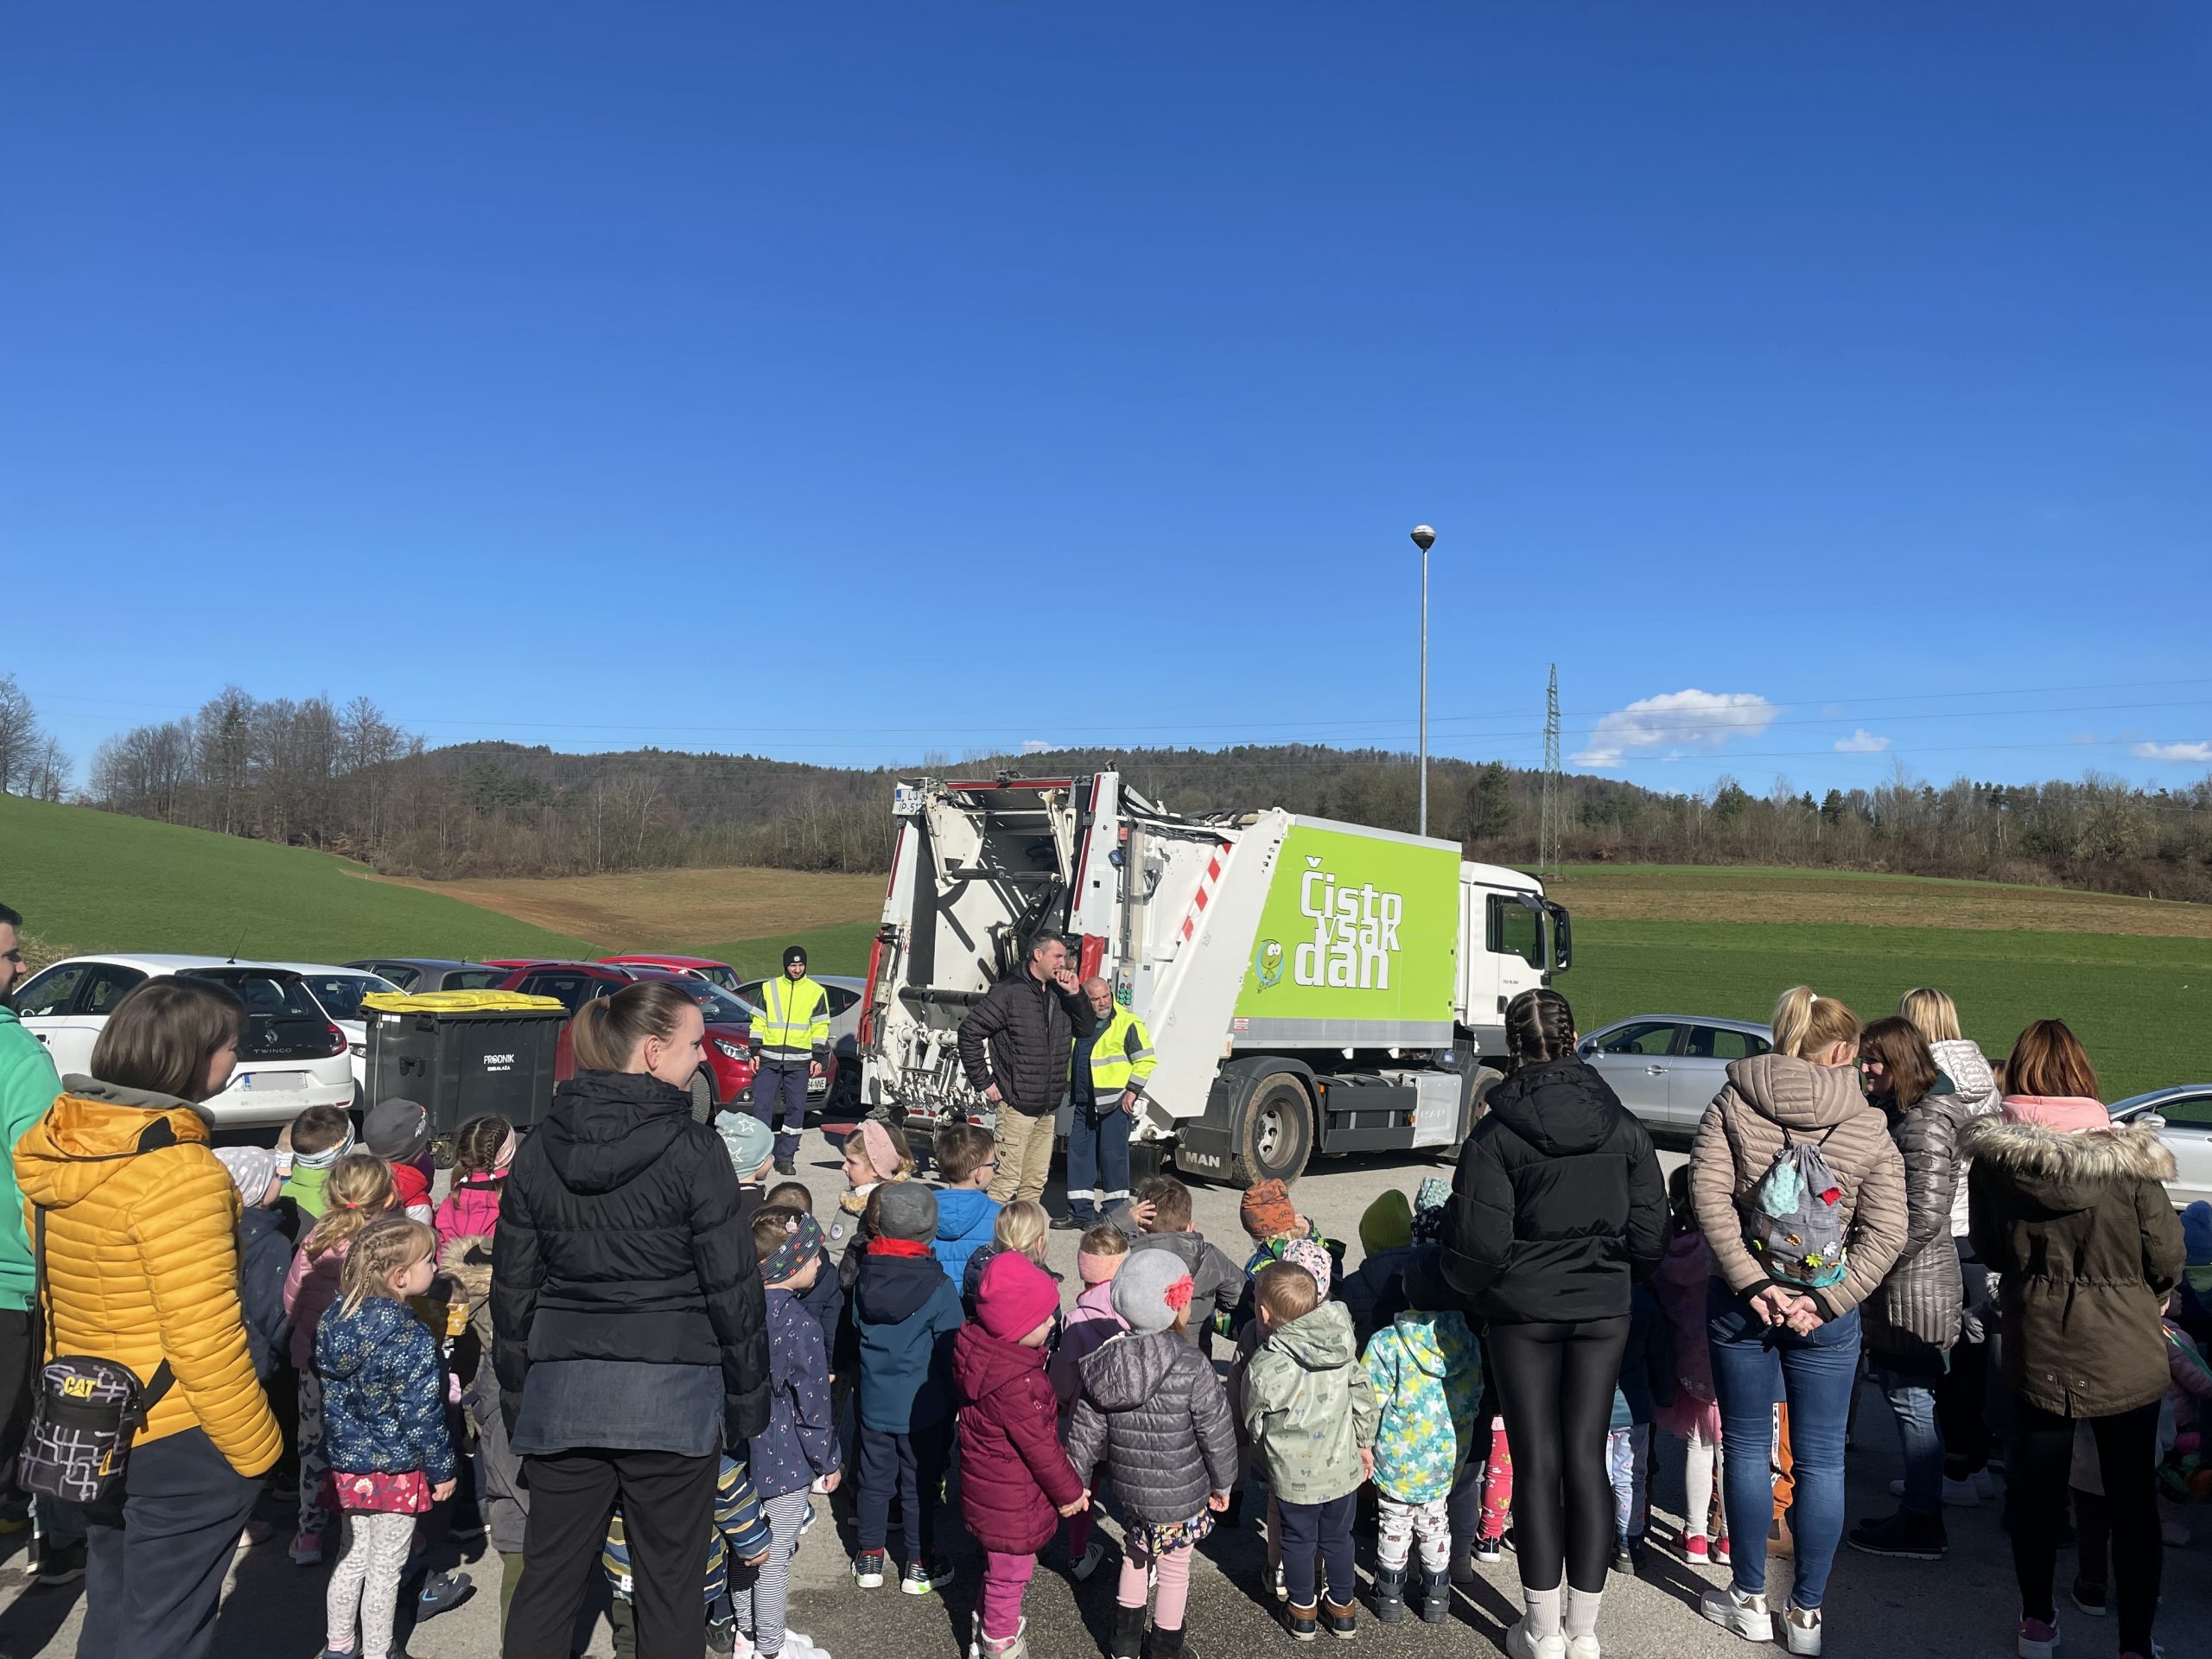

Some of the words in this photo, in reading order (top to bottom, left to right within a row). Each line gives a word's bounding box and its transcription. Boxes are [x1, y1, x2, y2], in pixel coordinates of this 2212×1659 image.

[1300, 855, 1402, 925] Čisto
[1315, 913, 1401, 951] vsak
[1294, 928, 1389, 990] dan
[483, 1053, 515, 1065] PRODNIK
[1185, 1151, 1220, 1168] MAN
[63, 1376, 97, 1398] CAT
